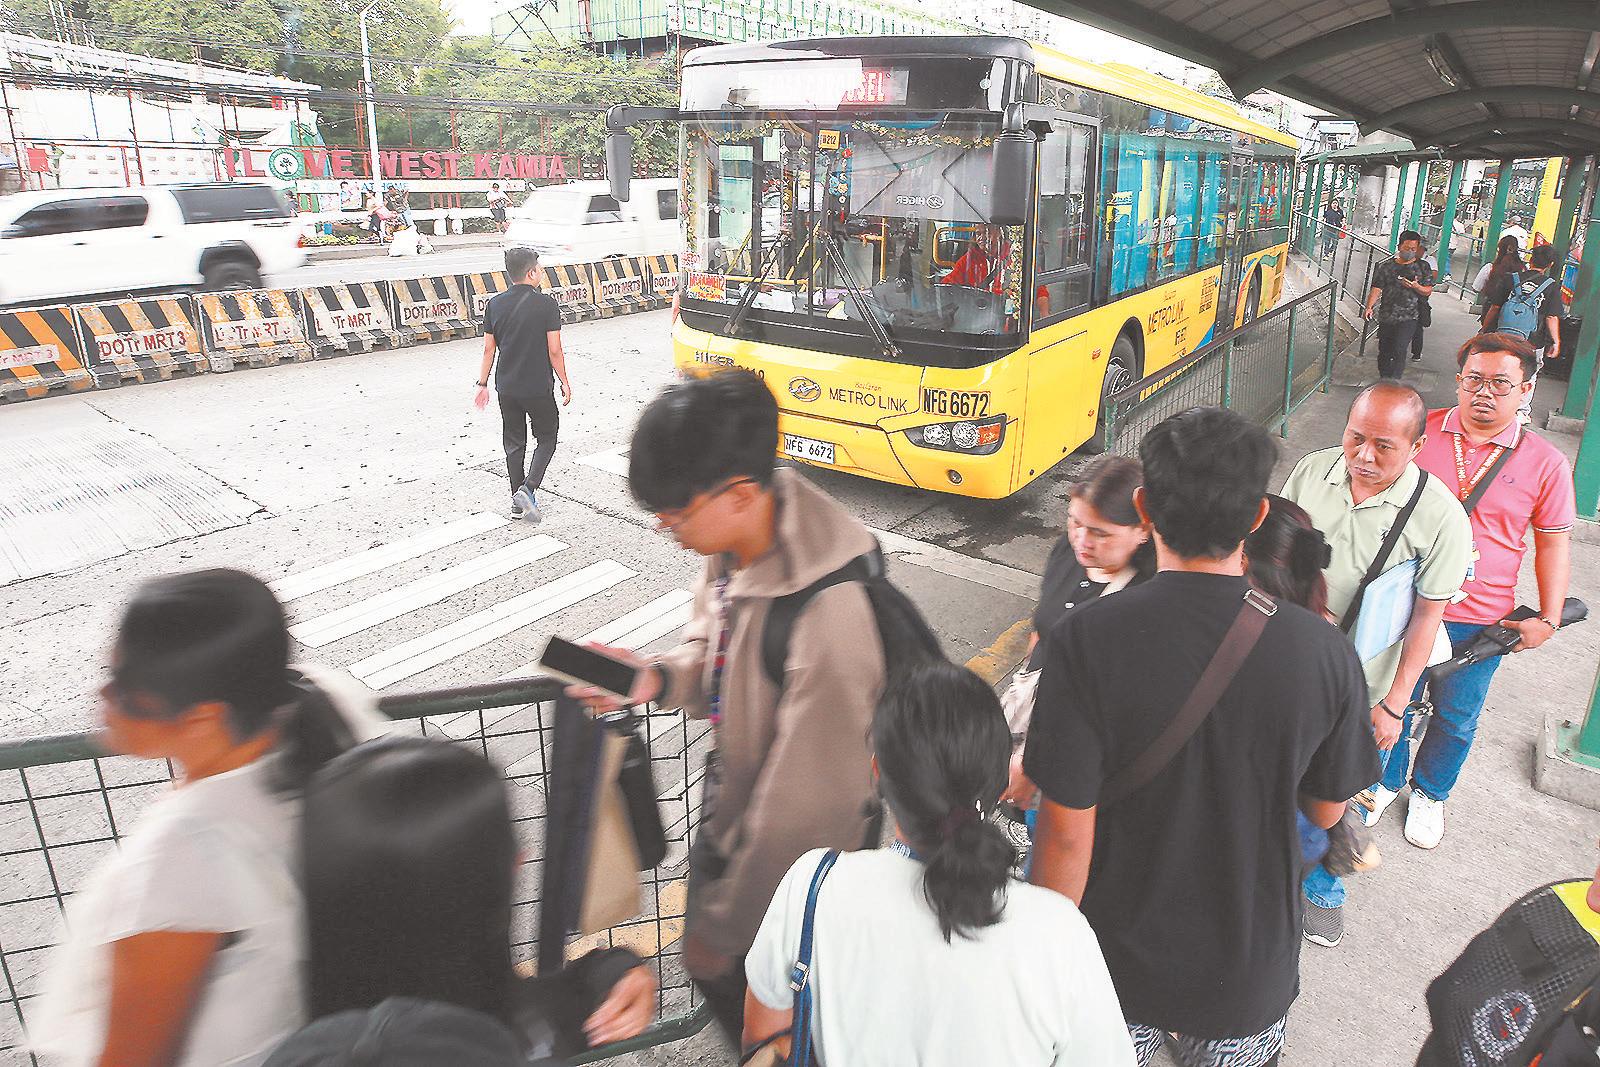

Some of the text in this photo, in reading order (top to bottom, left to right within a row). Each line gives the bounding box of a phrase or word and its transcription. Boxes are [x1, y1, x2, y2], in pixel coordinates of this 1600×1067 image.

[369, 150, 463, 179] WEST
[473, 153, 568, 180] KAMIA
[404, 306, 429, 320] DOTr
[100, 338, 140, 357] DOTr
[922, 388, 991, 417] NFG 6672
[785, 438, 833, 460] NFG 6672
